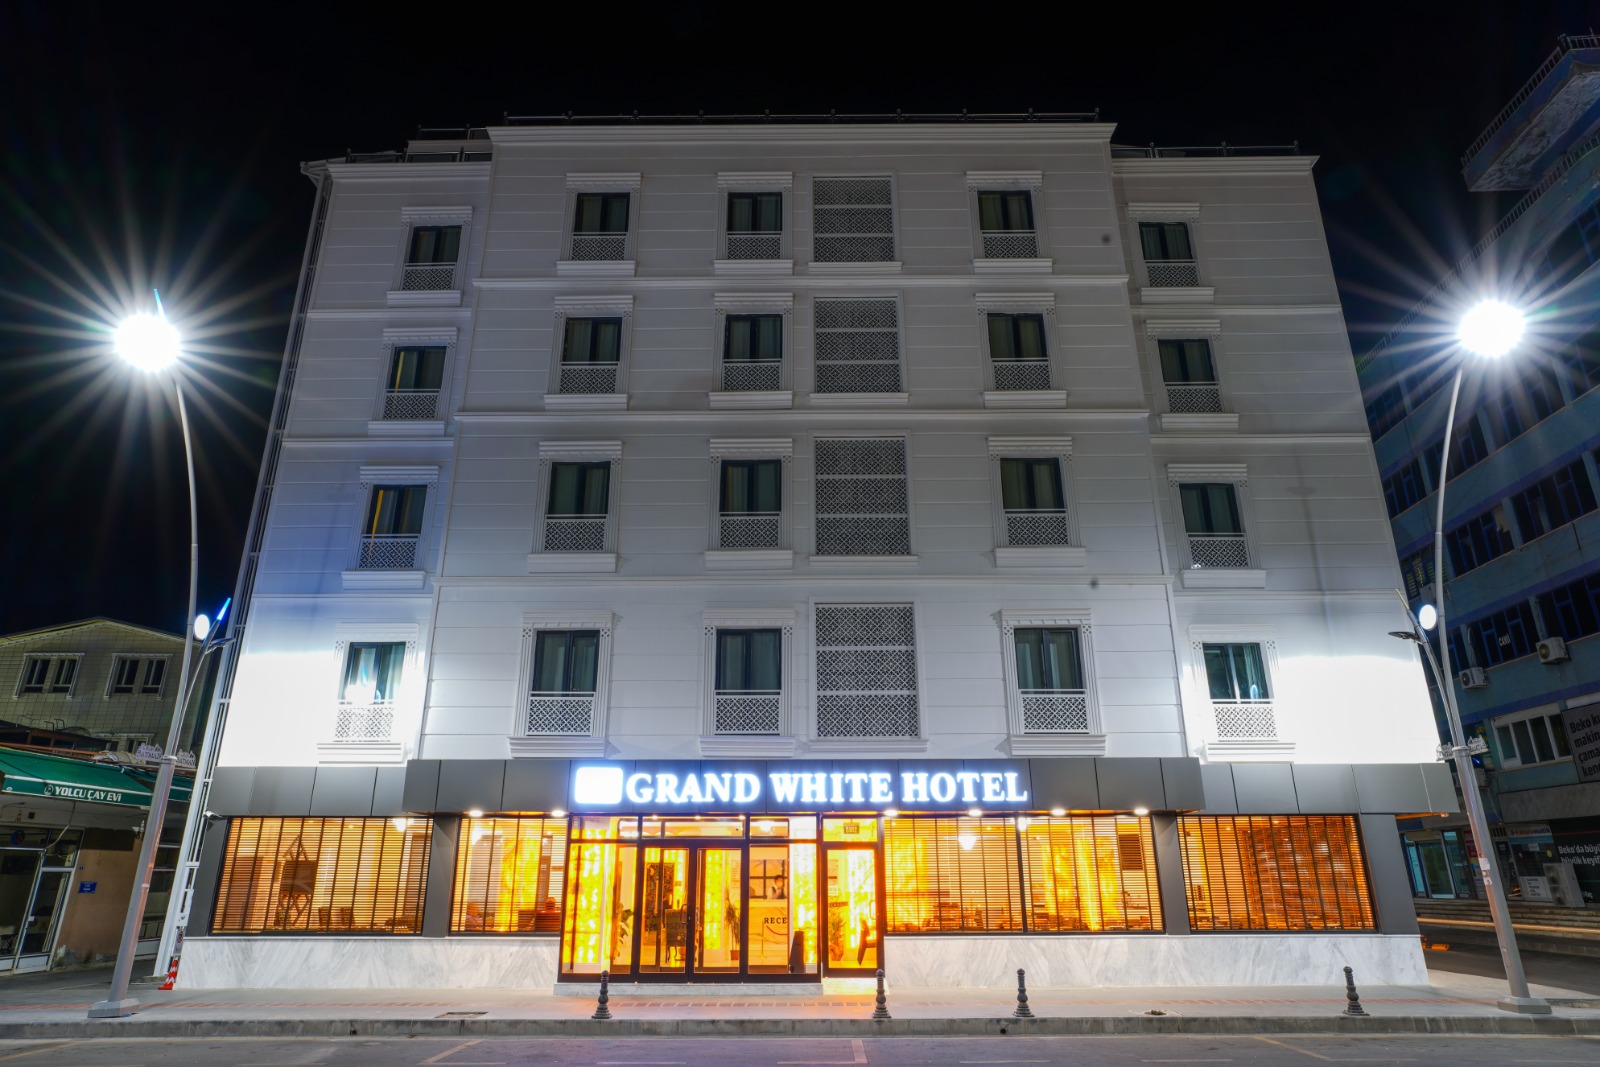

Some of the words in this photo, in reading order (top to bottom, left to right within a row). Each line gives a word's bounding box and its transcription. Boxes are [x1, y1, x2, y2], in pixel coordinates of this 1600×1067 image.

[1569, 718, 1592, 733] Beko
[55, 786, 87, 799] YOLCU
[87, 791, 107, 802] ÇAY
[625, 773, 761, 803] GRAND
[769, 772, 894, 803] WHITE
[900, 772, 1028, 803] HOTEL
[1558, 845, 1584, 854] Beko'da
